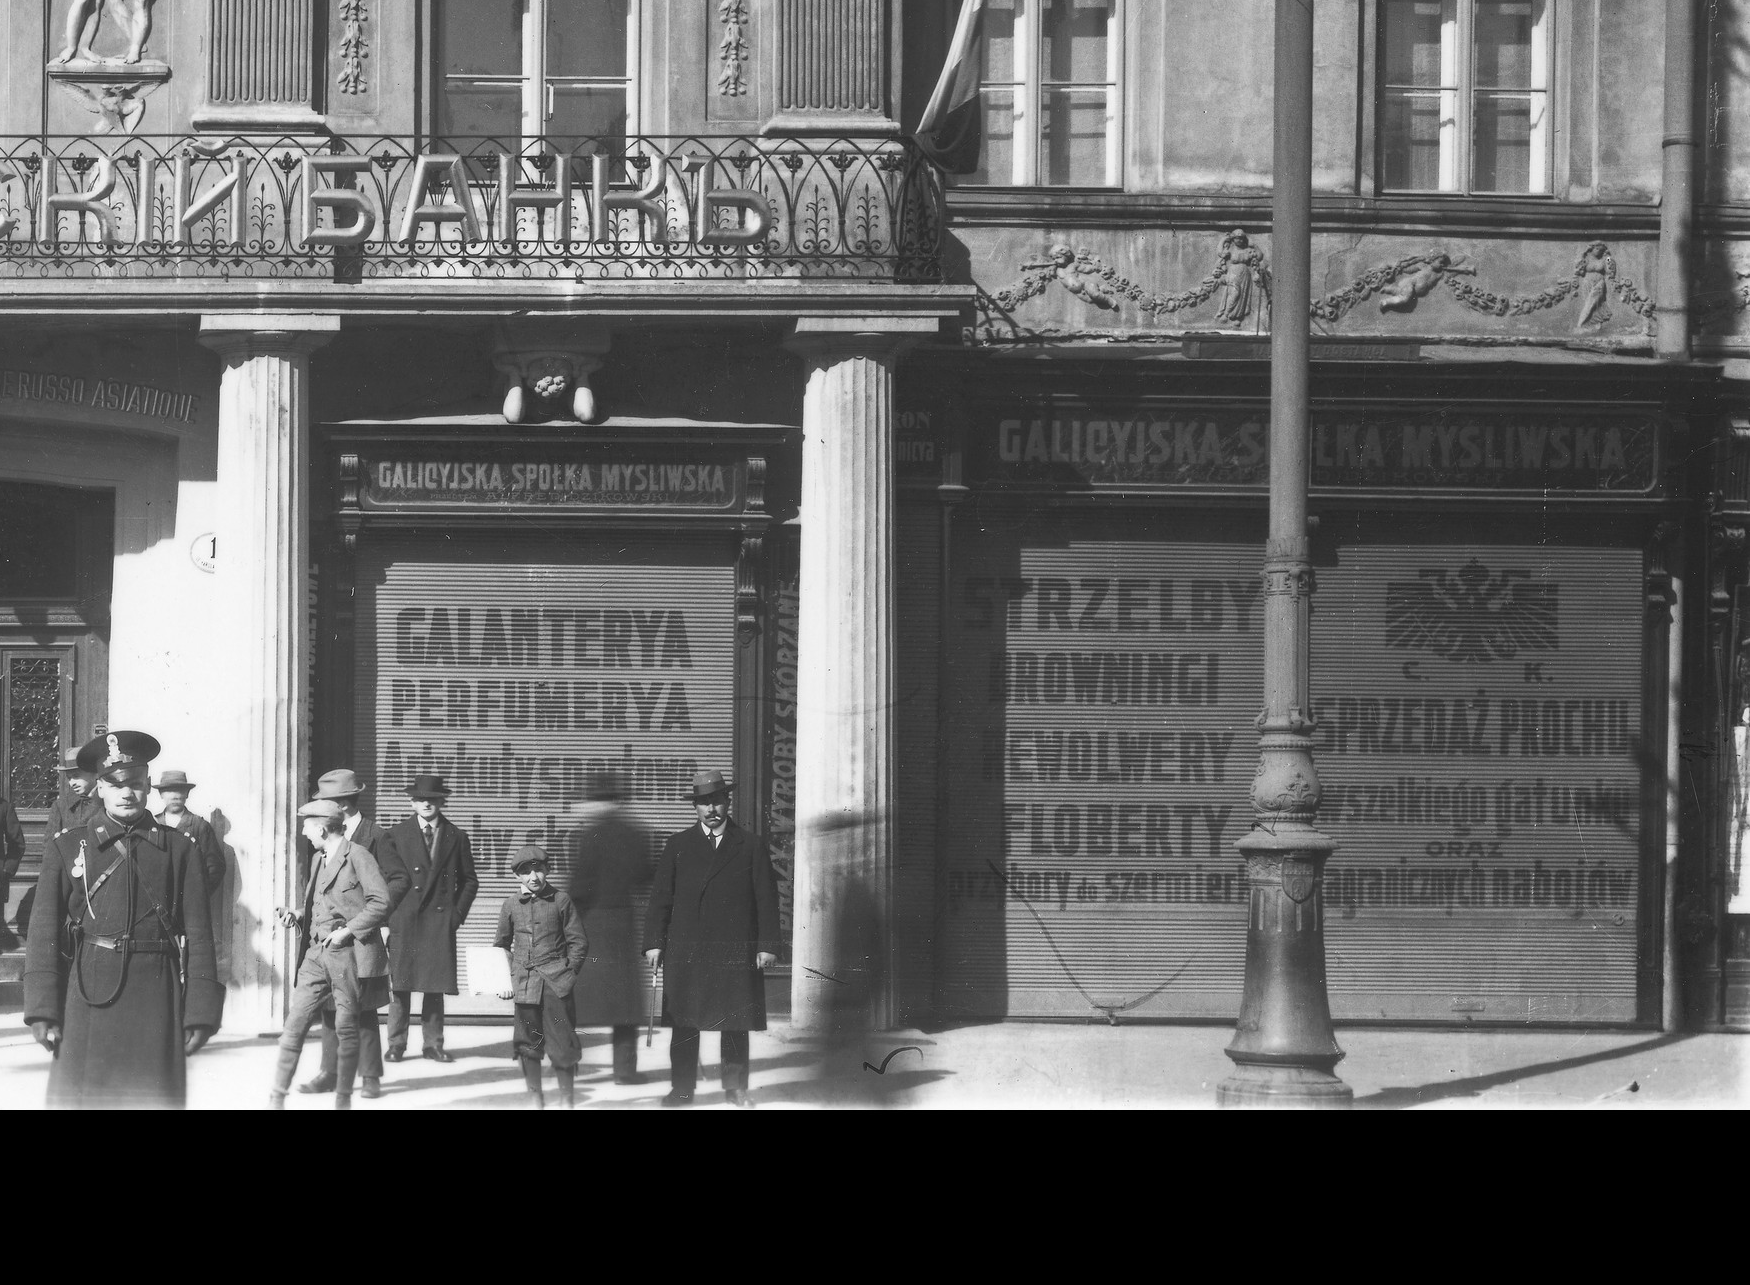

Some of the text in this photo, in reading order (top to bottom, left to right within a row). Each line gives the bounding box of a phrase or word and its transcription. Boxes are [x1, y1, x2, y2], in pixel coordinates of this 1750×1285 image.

[301, 151, 773, 247] БАНКЪ
[17, 371, 85, 405] RUSSO
[90, 380, 200, 424] ASIATIQUE
[963, 577, 1264, 633] STRZELBY
[395, 607, 693, 669] GALANTERYA
[391, 680, 692, 731] PERFUMERYA
[1499, 699, 1631, 758] PROCHU
[1002, 802, 1233, 857] FLOBERTY
[1424, 840, 1505, 859] ORAZ
[1323, 856, 1486, 921] agranicznych
